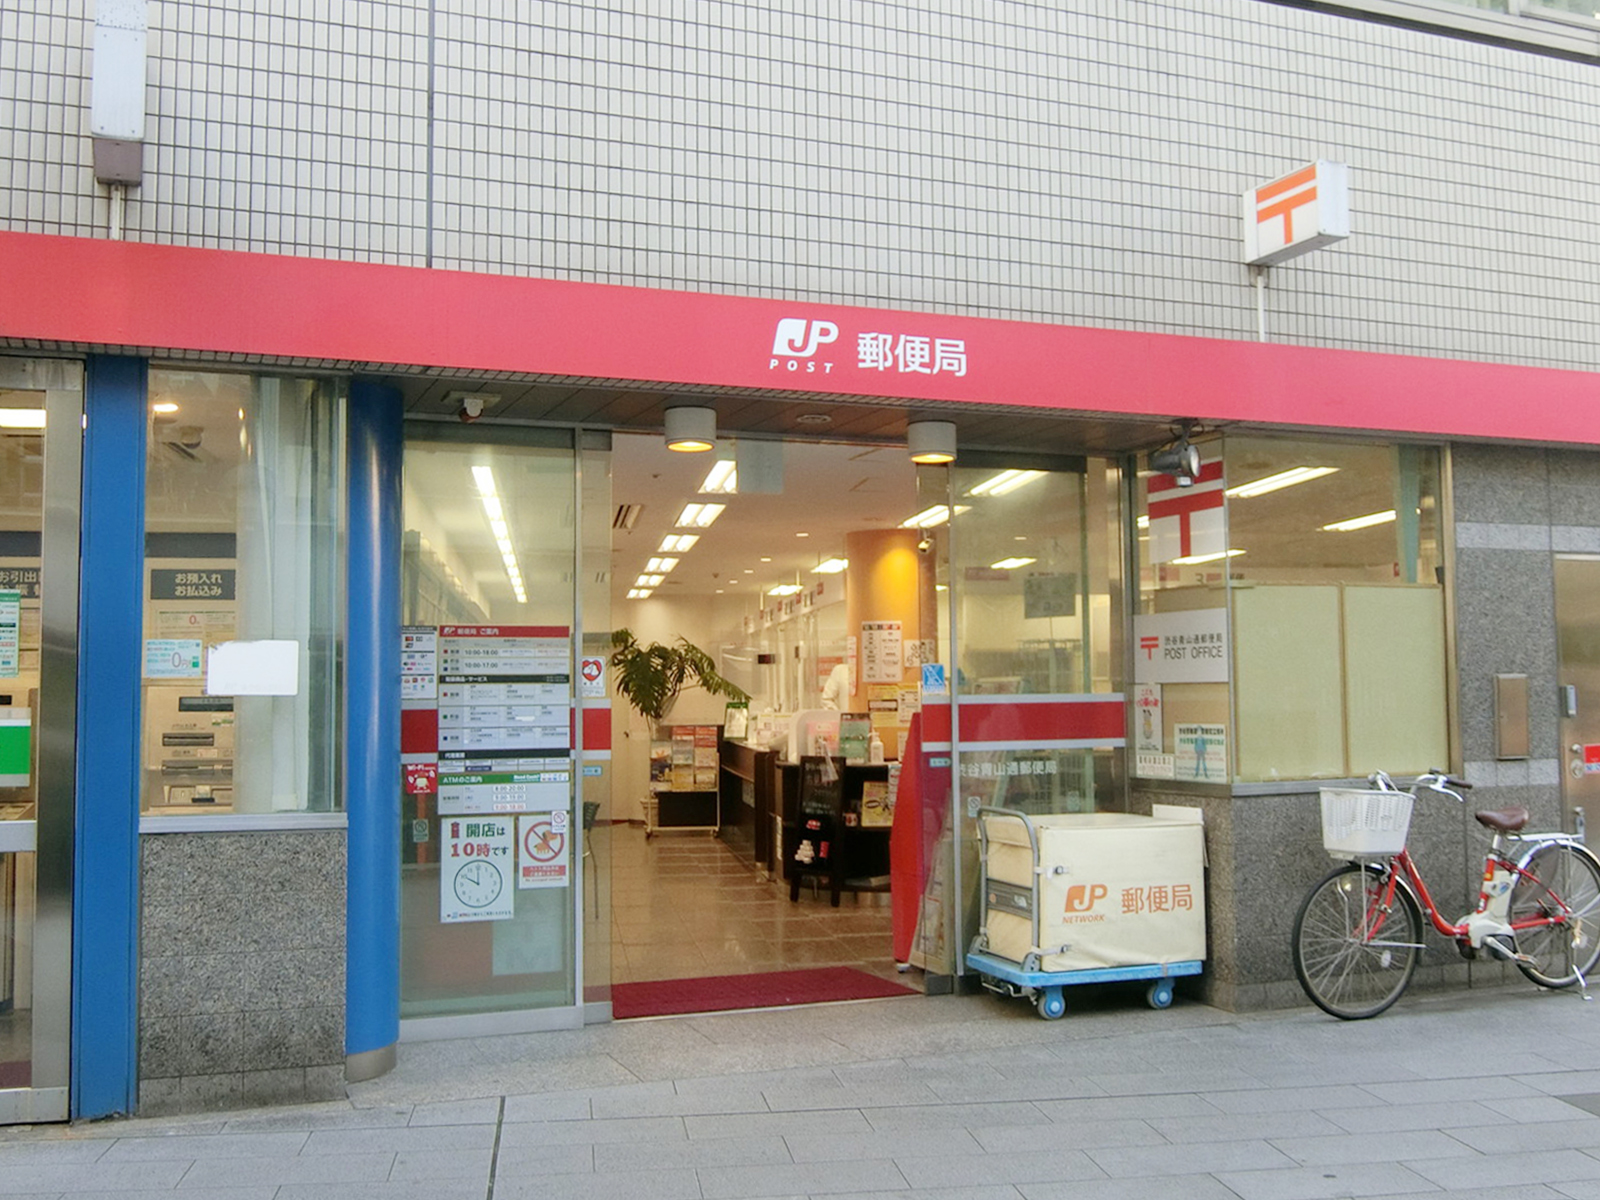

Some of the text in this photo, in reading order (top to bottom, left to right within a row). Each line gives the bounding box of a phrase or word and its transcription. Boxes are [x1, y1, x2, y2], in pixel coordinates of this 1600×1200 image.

[857, 332, 967, 377] 郵便局
[769, 358, 833, 373] POST
[175, 573, 222, 584] お預入れ
[175, 585, 222, 597] お払込み
[1164, 646, 1223, 660] POST OFFICE
[466, 822, 505, 838] 開店は
[451, 842, 509, 857] 10時です
[1121, 884, 1193, 915] 郵便局
[1062, 914, 1105, 924] NETWORK
